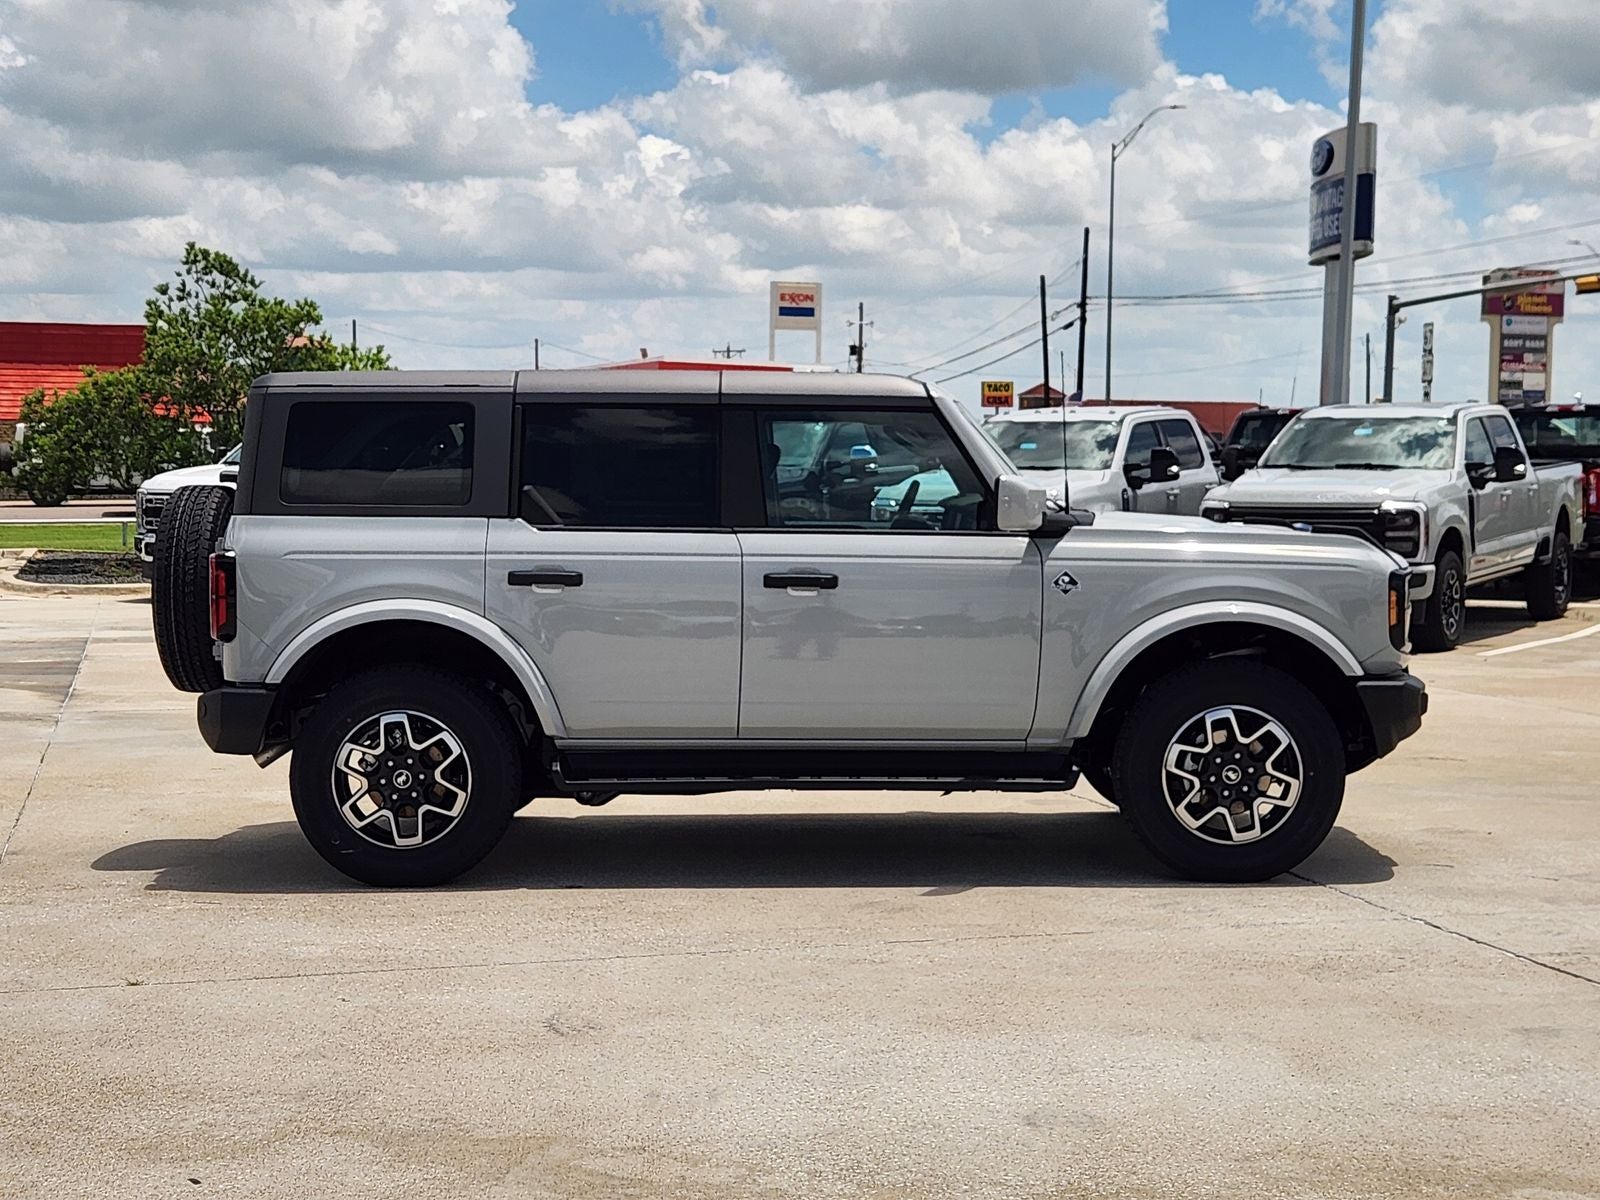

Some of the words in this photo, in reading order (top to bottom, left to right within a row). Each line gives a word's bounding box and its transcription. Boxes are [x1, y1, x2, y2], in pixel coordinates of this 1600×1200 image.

[779, 292, 814, 305] EXXON
[986, 383, 1010, 392] TACO
[986, 396, 1010, 405] CASA
